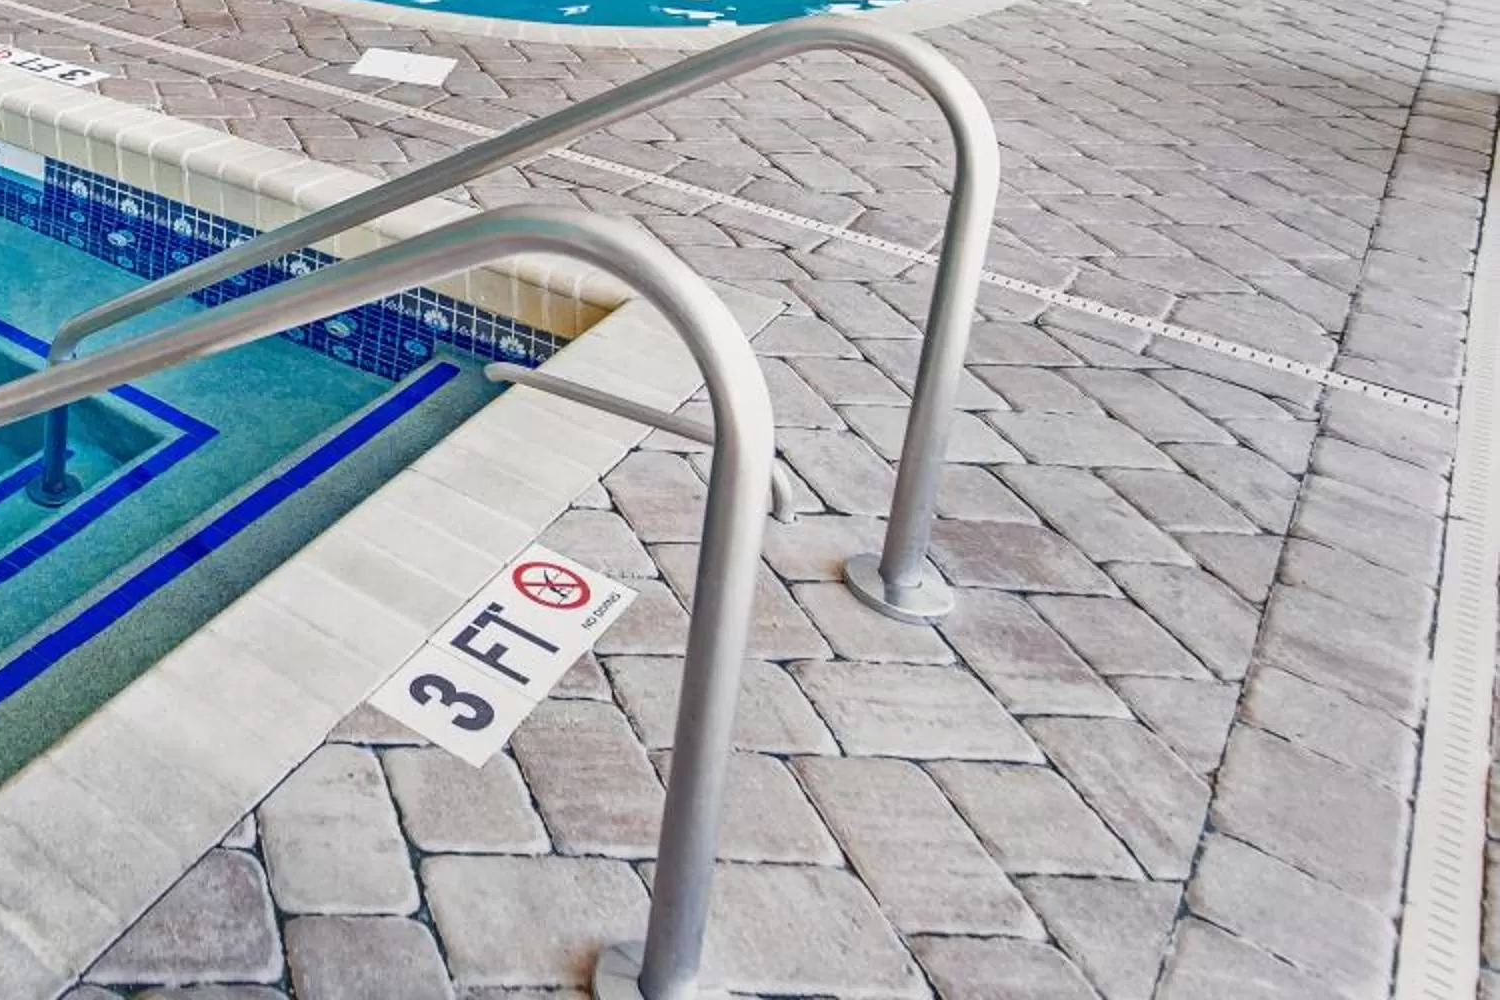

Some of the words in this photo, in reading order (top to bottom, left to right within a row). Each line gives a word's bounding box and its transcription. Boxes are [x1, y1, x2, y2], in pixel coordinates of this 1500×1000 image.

[8, 57, 63, 73] FT
[58, 68, 92, 81] 3
[580, 616, 598, 631] NO
[449, 600, 561, 686] FT
[408, 673, 496, 732] 3
